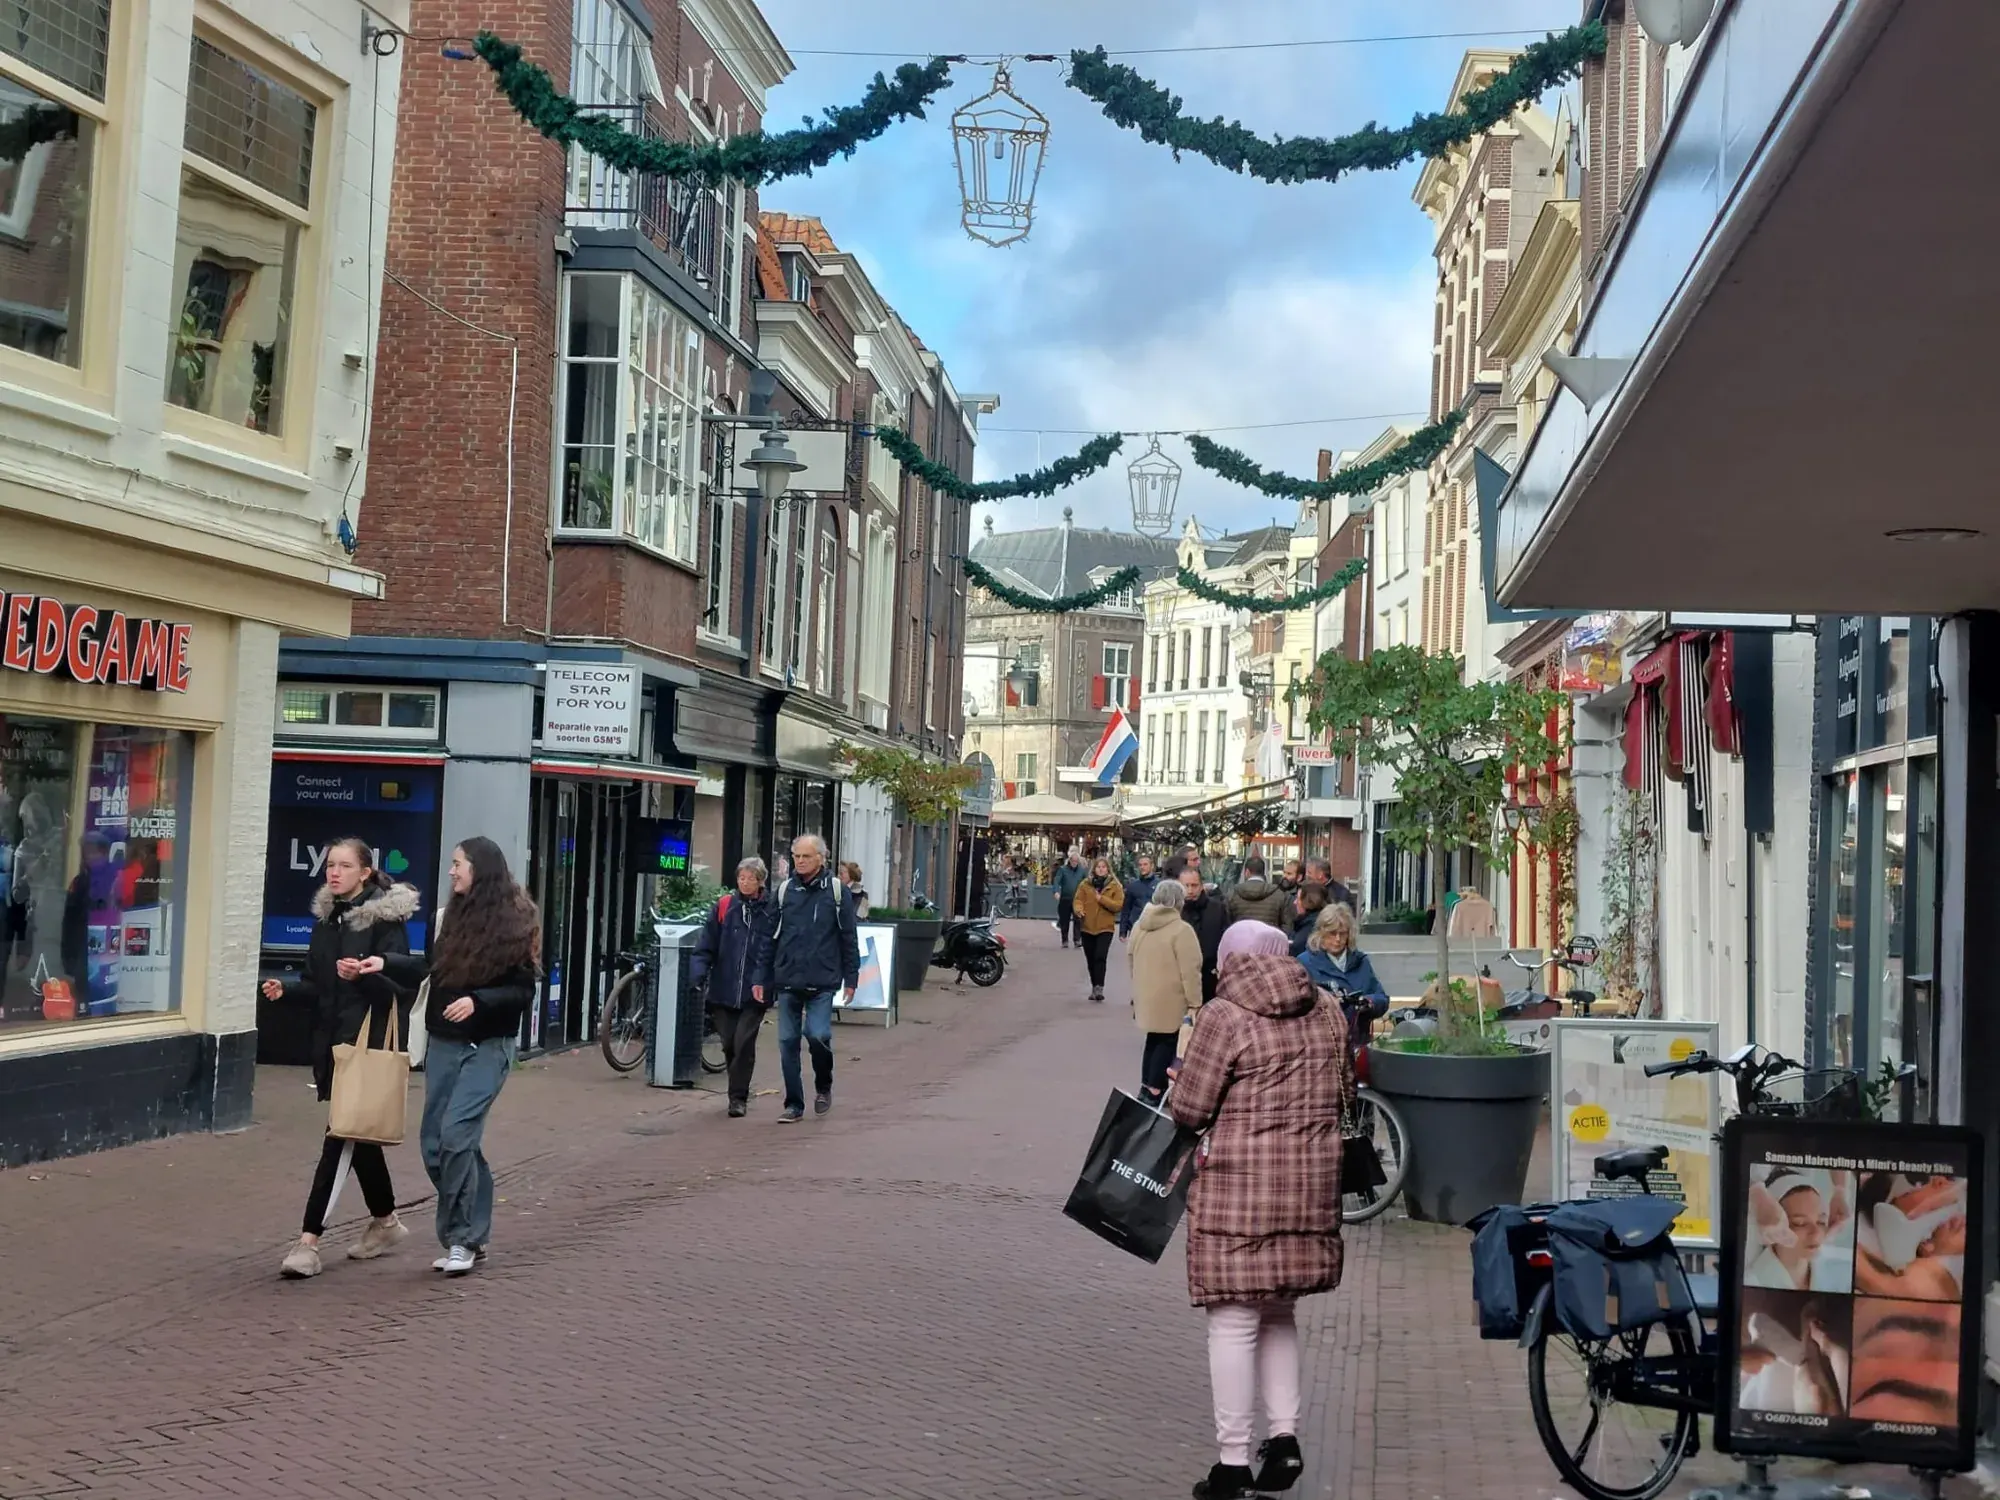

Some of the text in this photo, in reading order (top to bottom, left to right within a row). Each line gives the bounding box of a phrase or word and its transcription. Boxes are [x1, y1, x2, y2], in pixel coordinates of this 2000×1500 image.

[0, 590, 193, 693] EDGAME
[551, 670, 630, 682] TELECOM
[569, 684, 611, 695] STAR
[556, 698, 626, 710] FOR YOU
[548, 721, 591, 731] Reparatie
[593, 723, 610, 732] van
[556, 735, 590, 743] soorten
[296, 775, 341, 787] Connect
[296, 789, 354, 801] your world
[1572, 1116, 1606, 1128] ACTIE
[1110, 1158, 1133, 1179] THE
[1804, 1154, 1856, 1169] Hairstyling
[1857, 1160, 1865, 1169] &
[1898, 1161, 1932, 1174] Beauty
